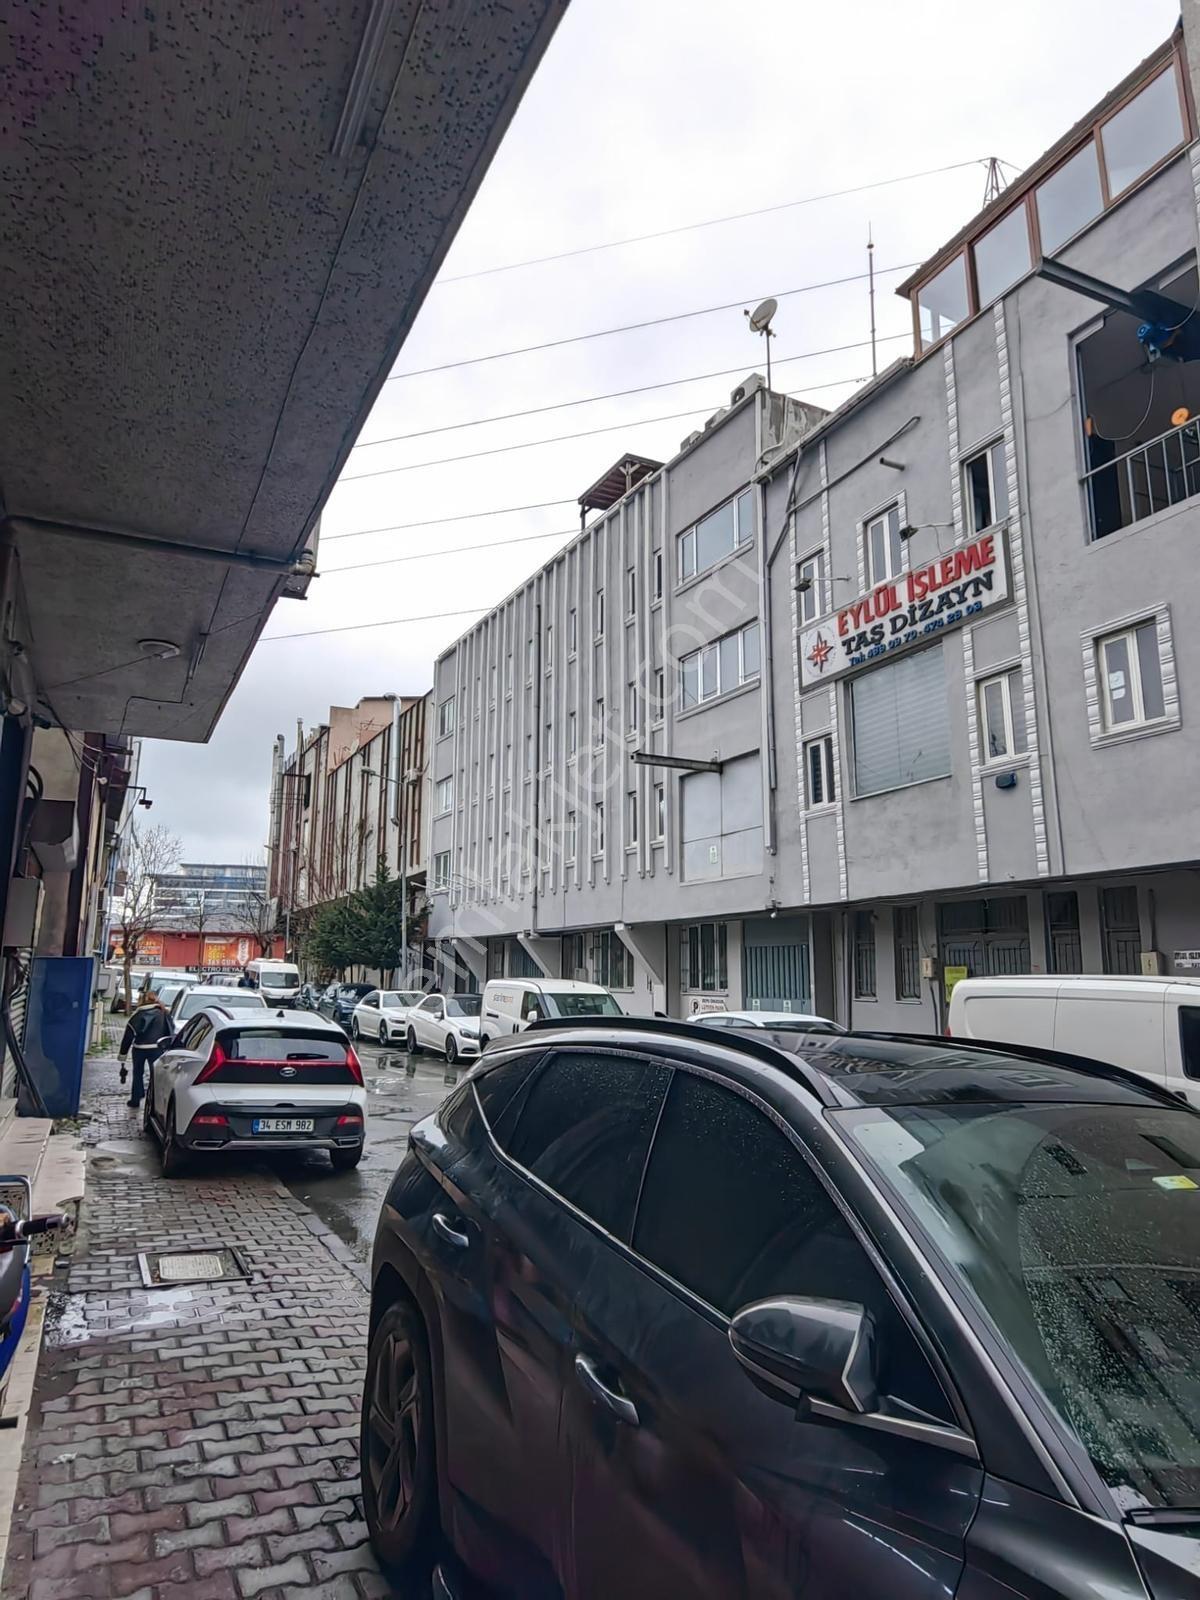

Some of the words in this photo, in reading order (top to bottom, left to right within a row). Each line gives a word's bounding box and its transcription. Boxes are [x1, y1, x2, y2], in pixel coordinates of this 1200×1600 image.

[837, 584, 902, 637] EYLÜL
[907, 535, 996, 603] İŞLEME
[842, 623, 885, 657] TAŞ
[890, 570, 994, 635] DİZAYN
[260, 1120, 271, 1130] 34
[296, 1120, 312, 1130] 982
